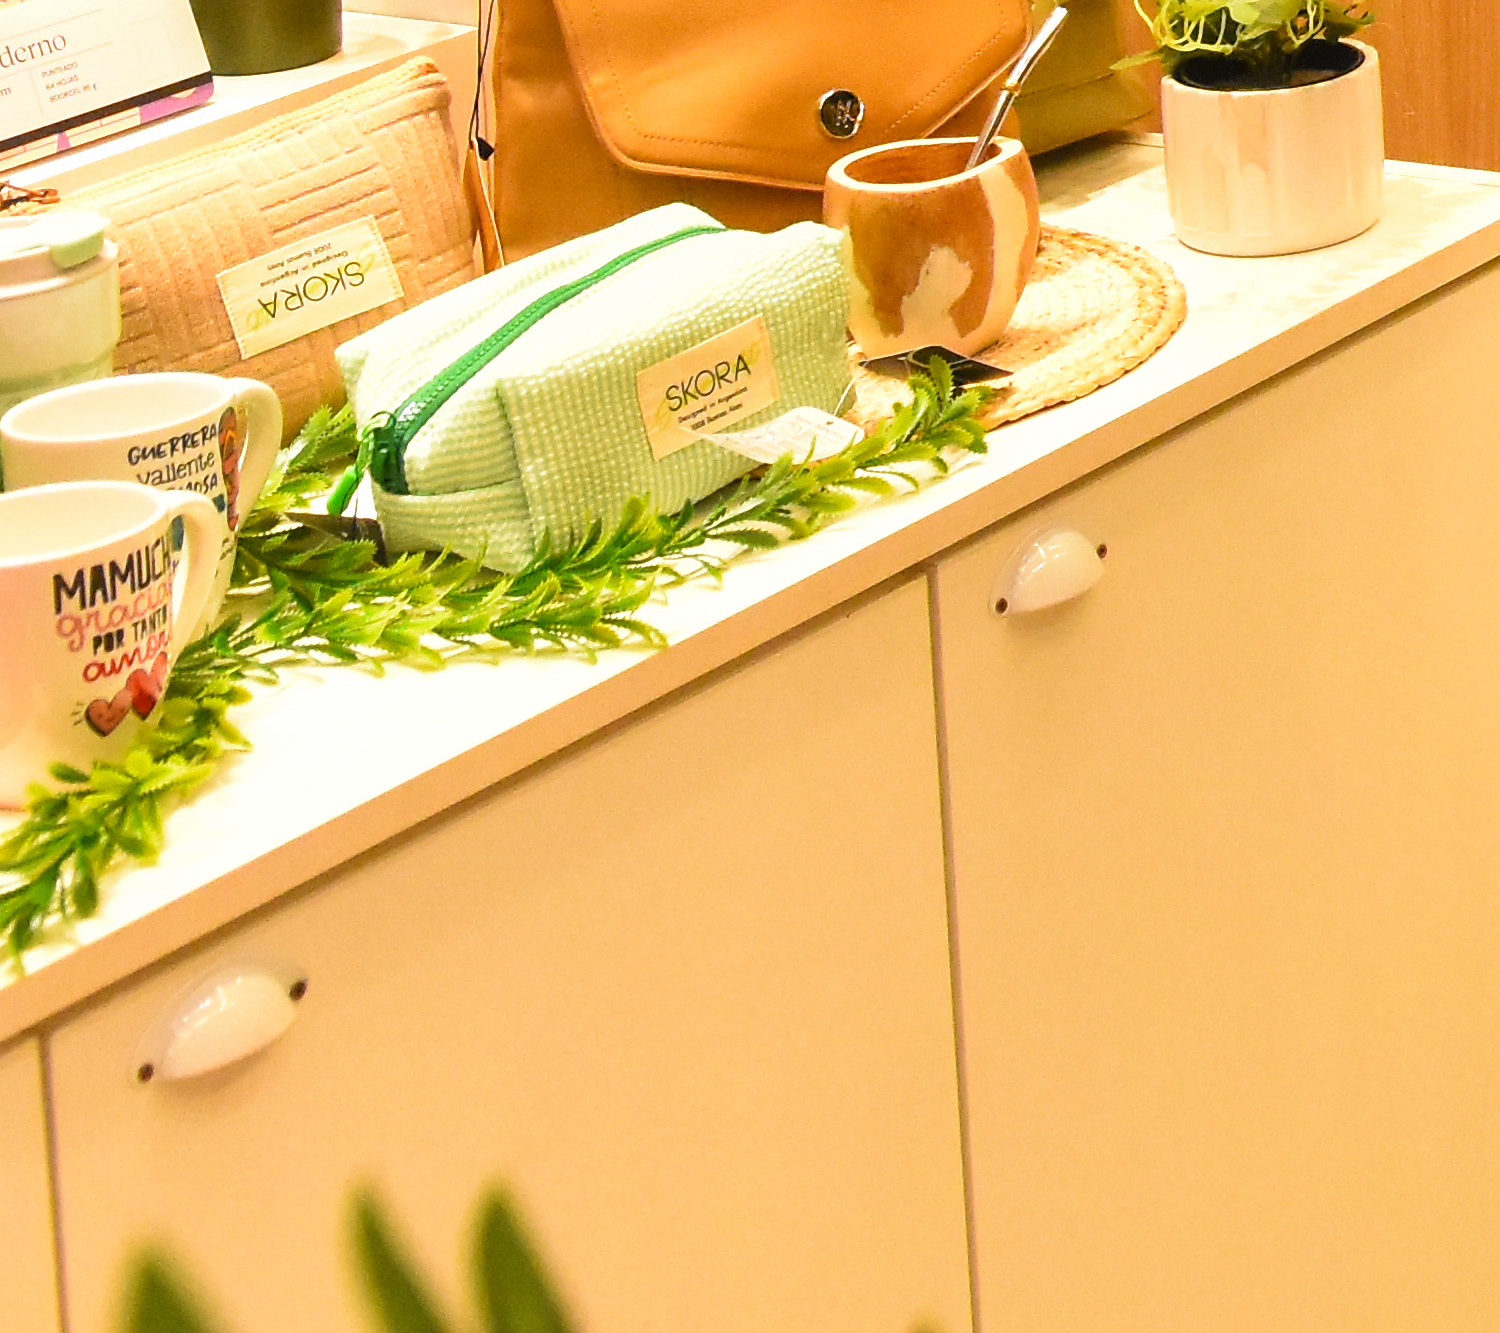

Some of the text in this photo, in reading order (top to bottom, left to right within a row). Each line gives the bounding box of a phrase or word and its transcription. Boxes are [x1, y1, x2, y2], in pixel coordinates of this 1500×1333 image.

[257, 261, 366, 319] SKORA
[665, 353, 752, 412] SKORA
[127, 422, 218, 466] GUERRERA
[92, 627, 126, 657] POR
